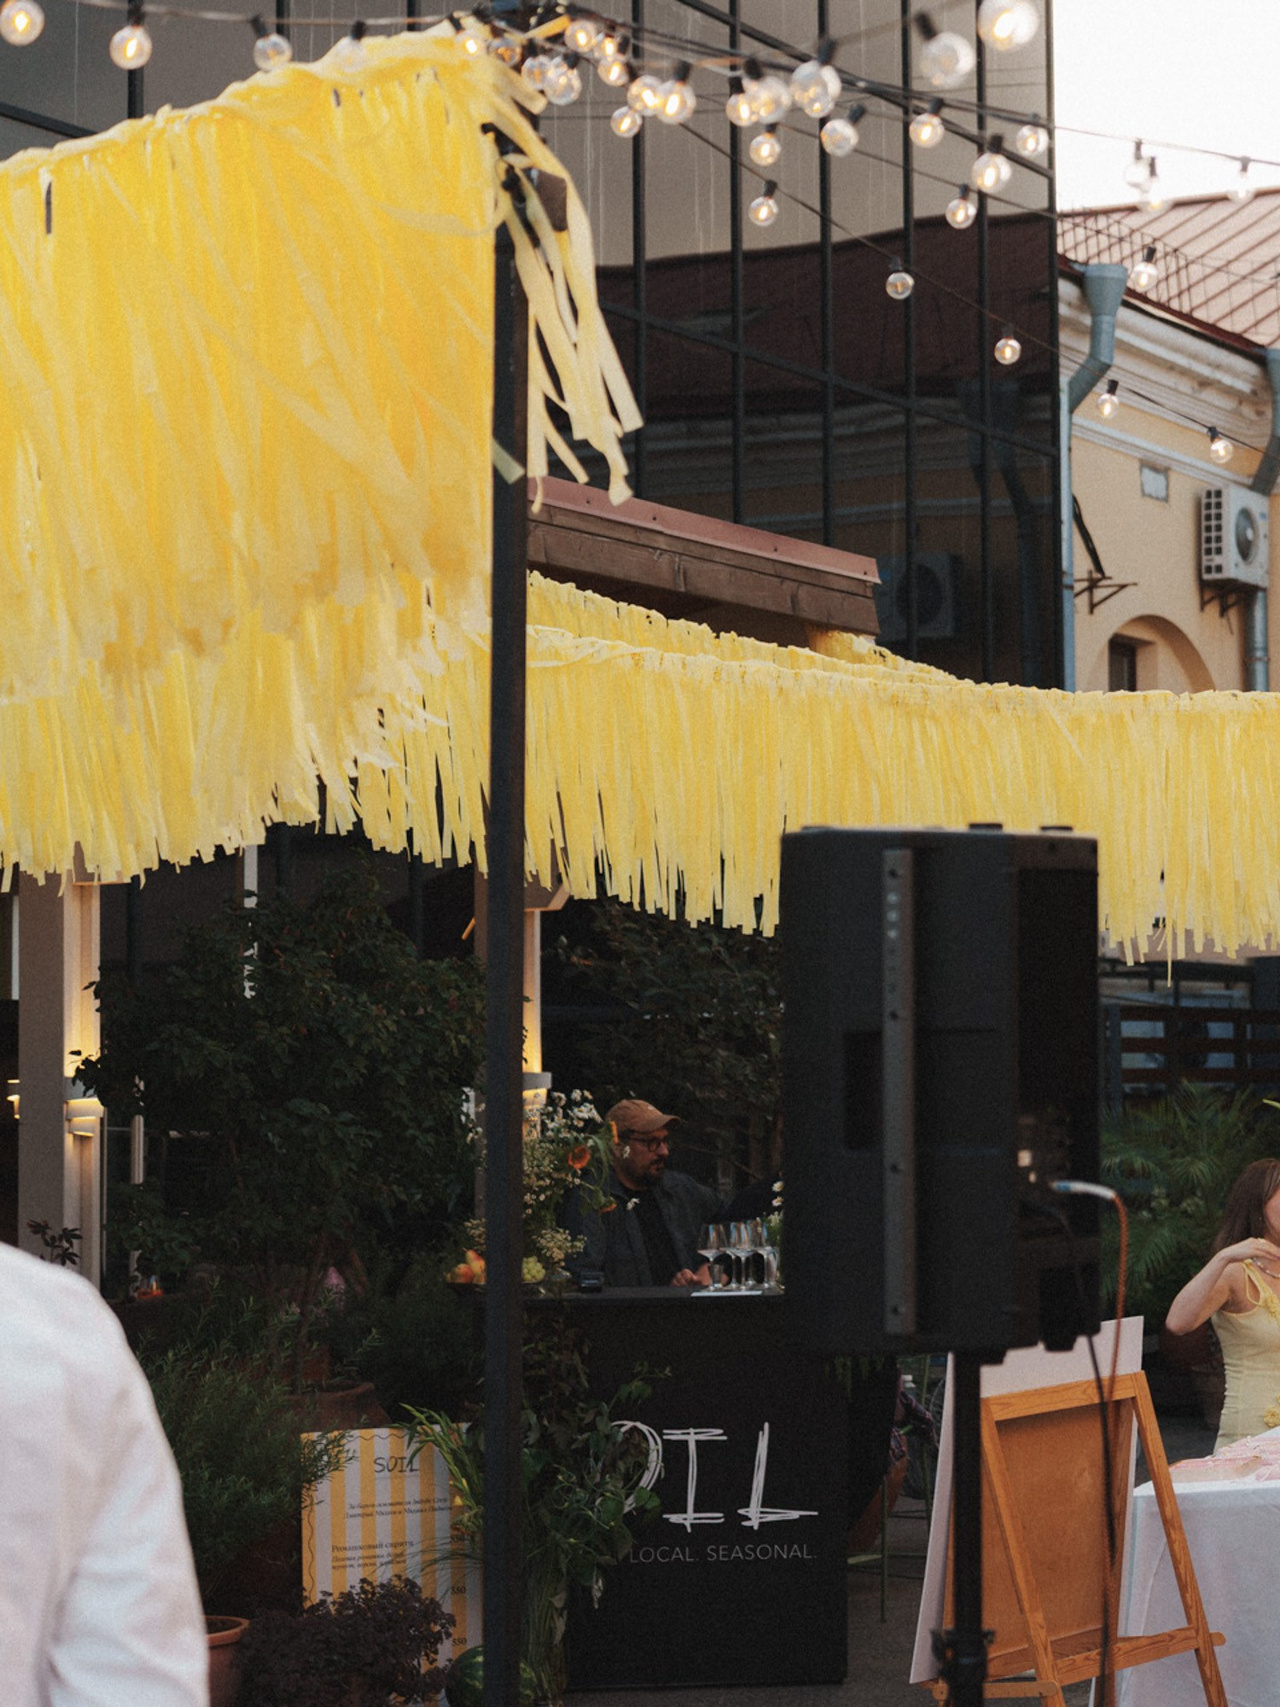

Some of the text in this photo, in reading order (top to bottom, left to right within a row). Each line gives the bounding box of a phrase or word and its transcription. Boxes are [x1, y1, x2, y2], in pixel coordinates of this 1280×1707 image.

[373, 1456, 420, 1473] SOIL
[598, 1420, 818, 1533] OIL
[629, 1543, 817, 1563] LOCAL. SEASONAL.
